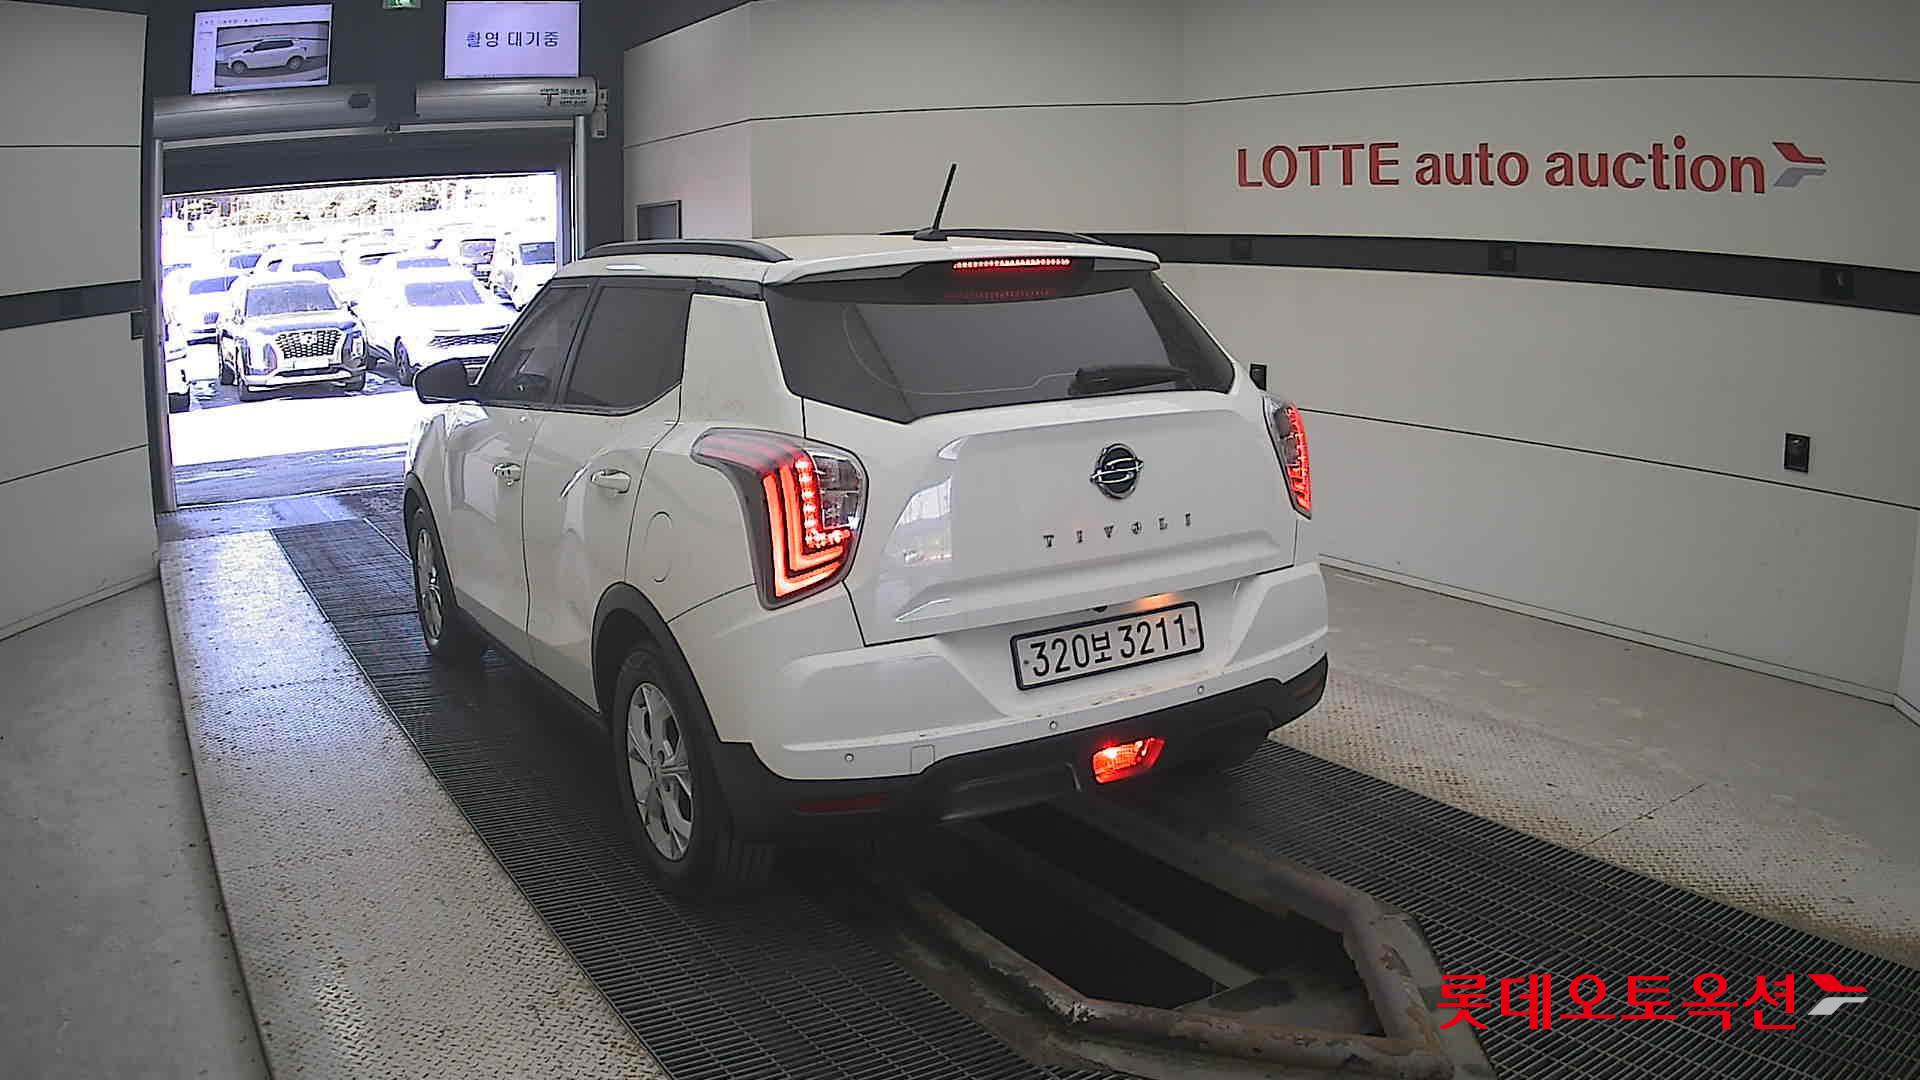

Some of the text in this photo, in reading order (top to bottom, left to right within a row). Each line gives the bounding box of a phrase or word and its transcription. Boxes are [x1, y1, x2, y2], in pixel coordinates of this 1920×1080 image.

[507, 30, 560, 48] 대기중
[1237, 135, 1766, 194] LOTTE auto auction
[1043, 512, 1191, 547] TIVOLI
